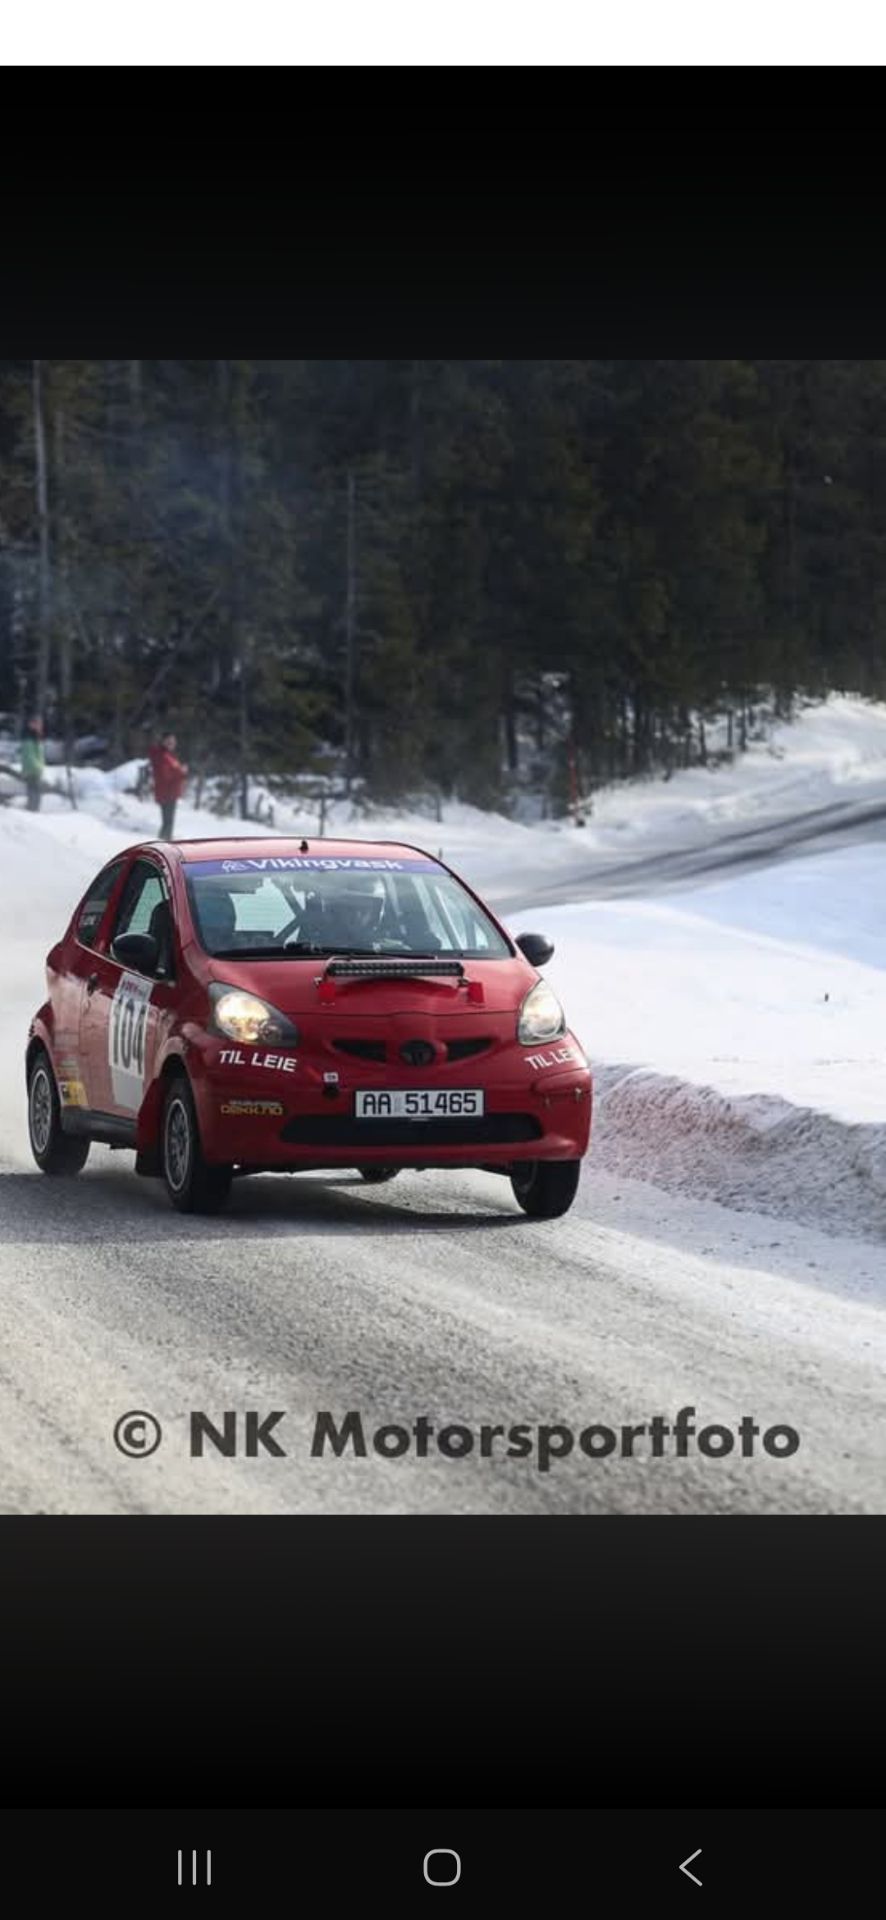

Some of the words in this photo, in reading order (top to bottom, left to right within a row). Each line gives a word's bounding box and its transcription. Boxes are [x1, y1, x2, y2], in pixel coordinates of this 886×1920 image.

[246, 857, 404, 870] Vikingvask
[112, 994, 147, 1076] 104
[218, 1050, 246, 1066] TIL
[250, 1052, 298, 1073] LEIE
[523, 1053, 554, 1071] TIL
[362, 1093, 392, 1115] AA
[404, 1092, 477, 1115] 51465
